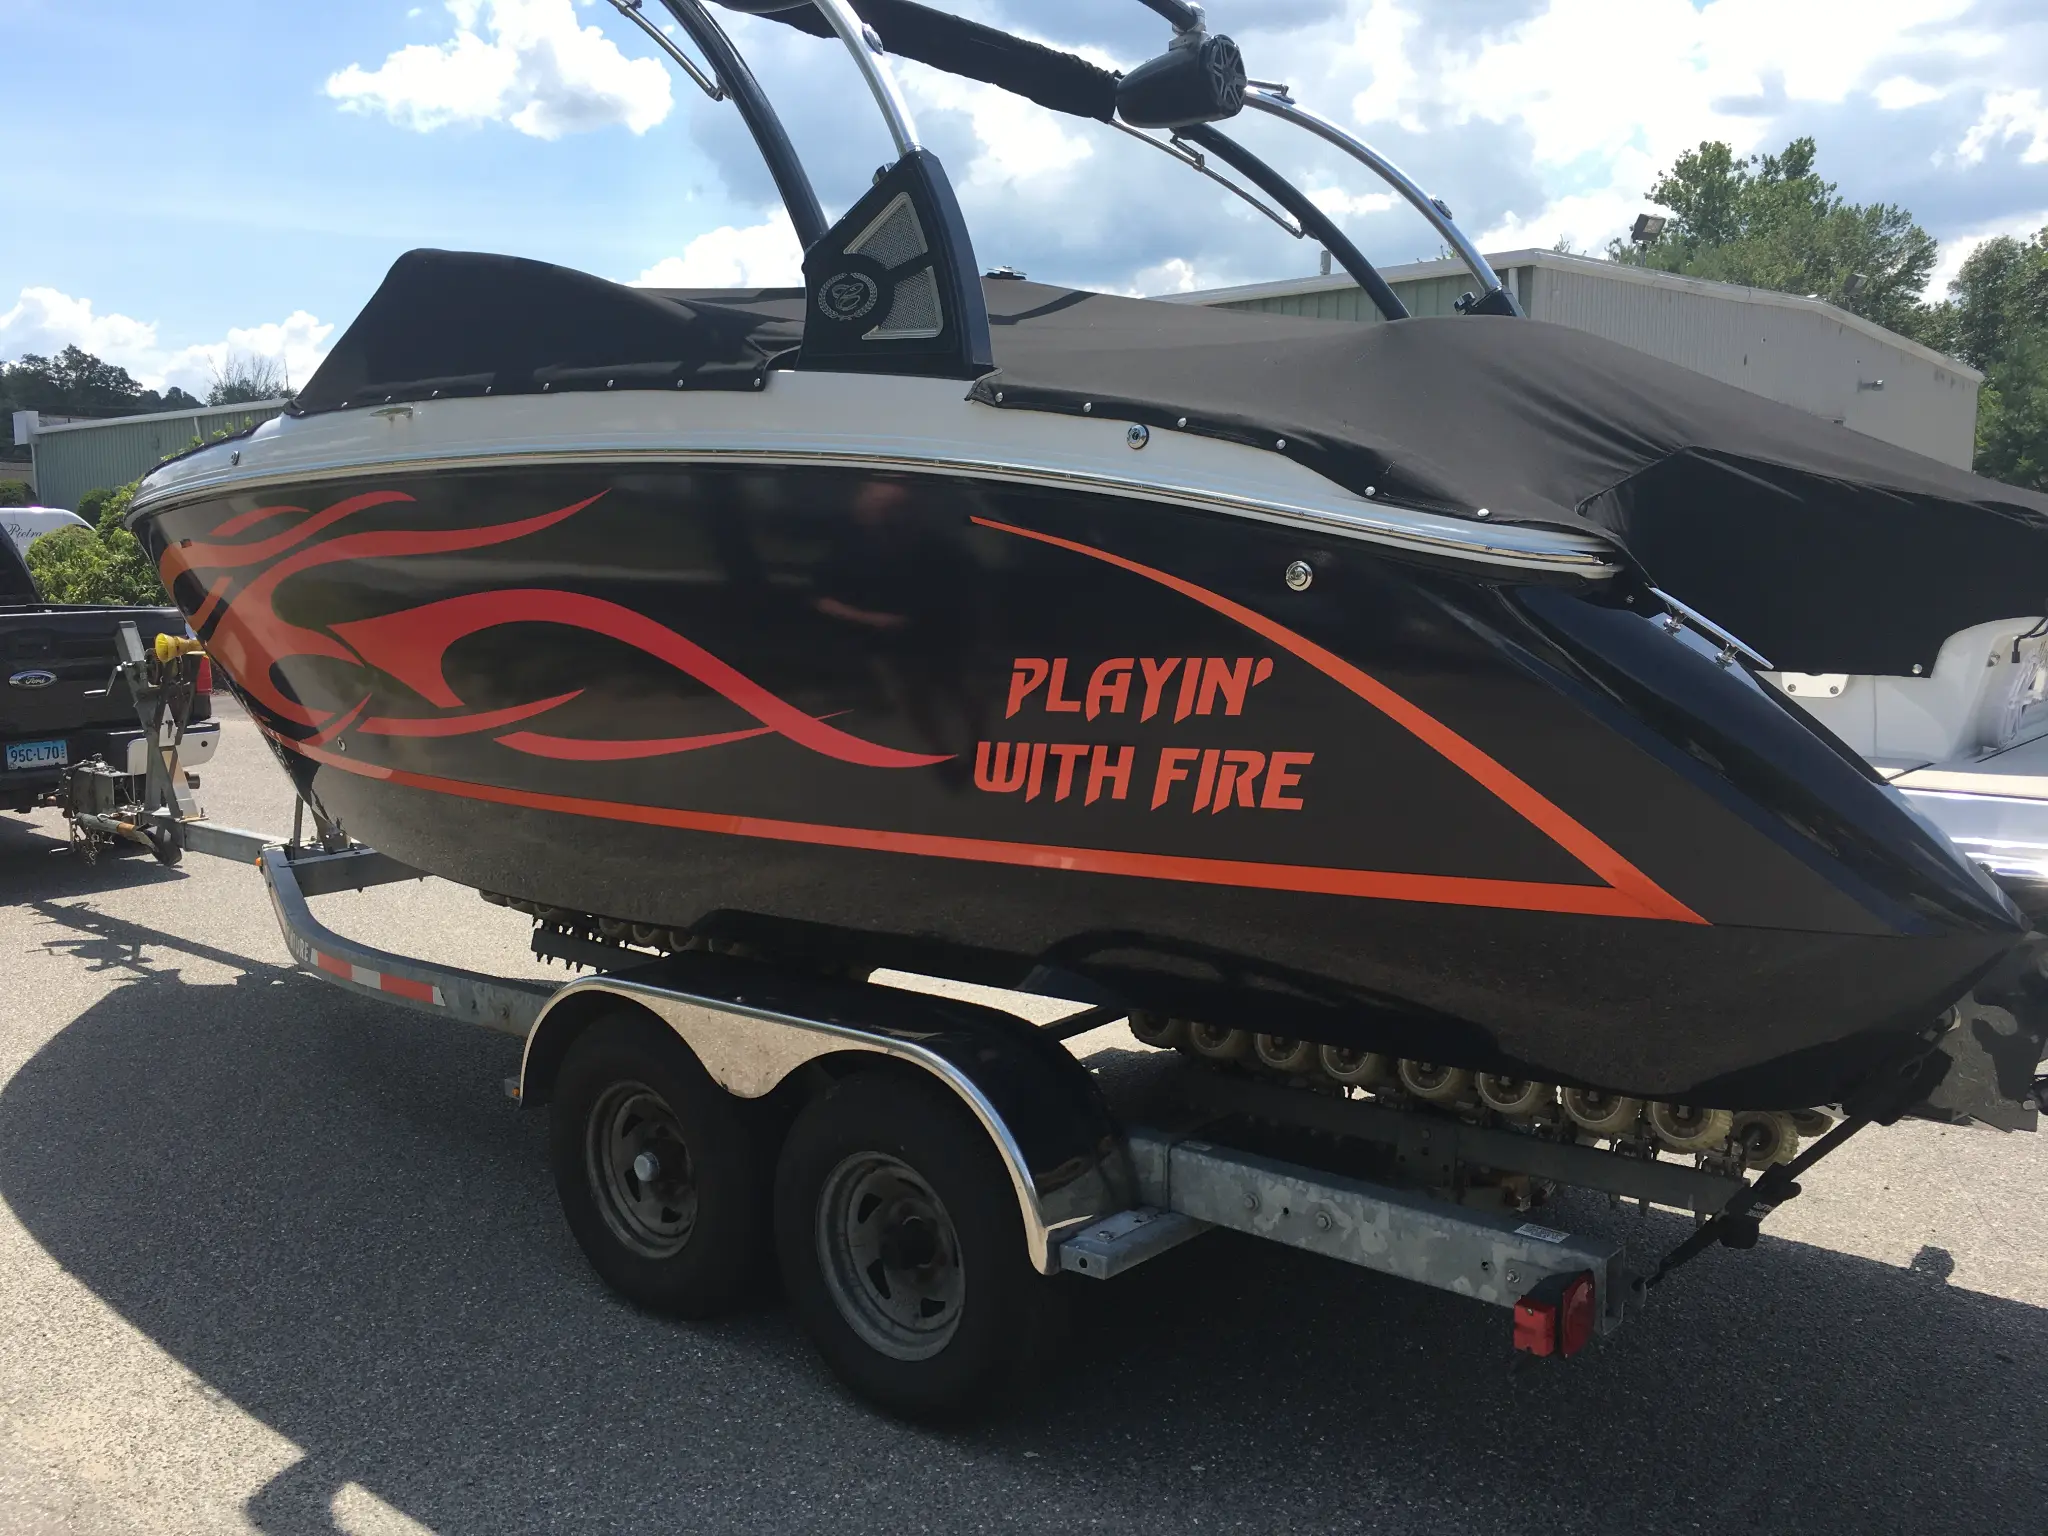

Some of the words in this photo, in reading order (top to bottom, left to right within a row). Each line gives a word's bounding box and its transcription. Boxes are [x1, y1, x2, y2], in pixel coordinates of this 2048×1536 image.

[25, 675, 46, 685] Ford
[1005, 657, 1274, 724] PLAYIN'
[973, 741, 1136, 807] WITH
[1150, 747, 1315, 815] FIRE
